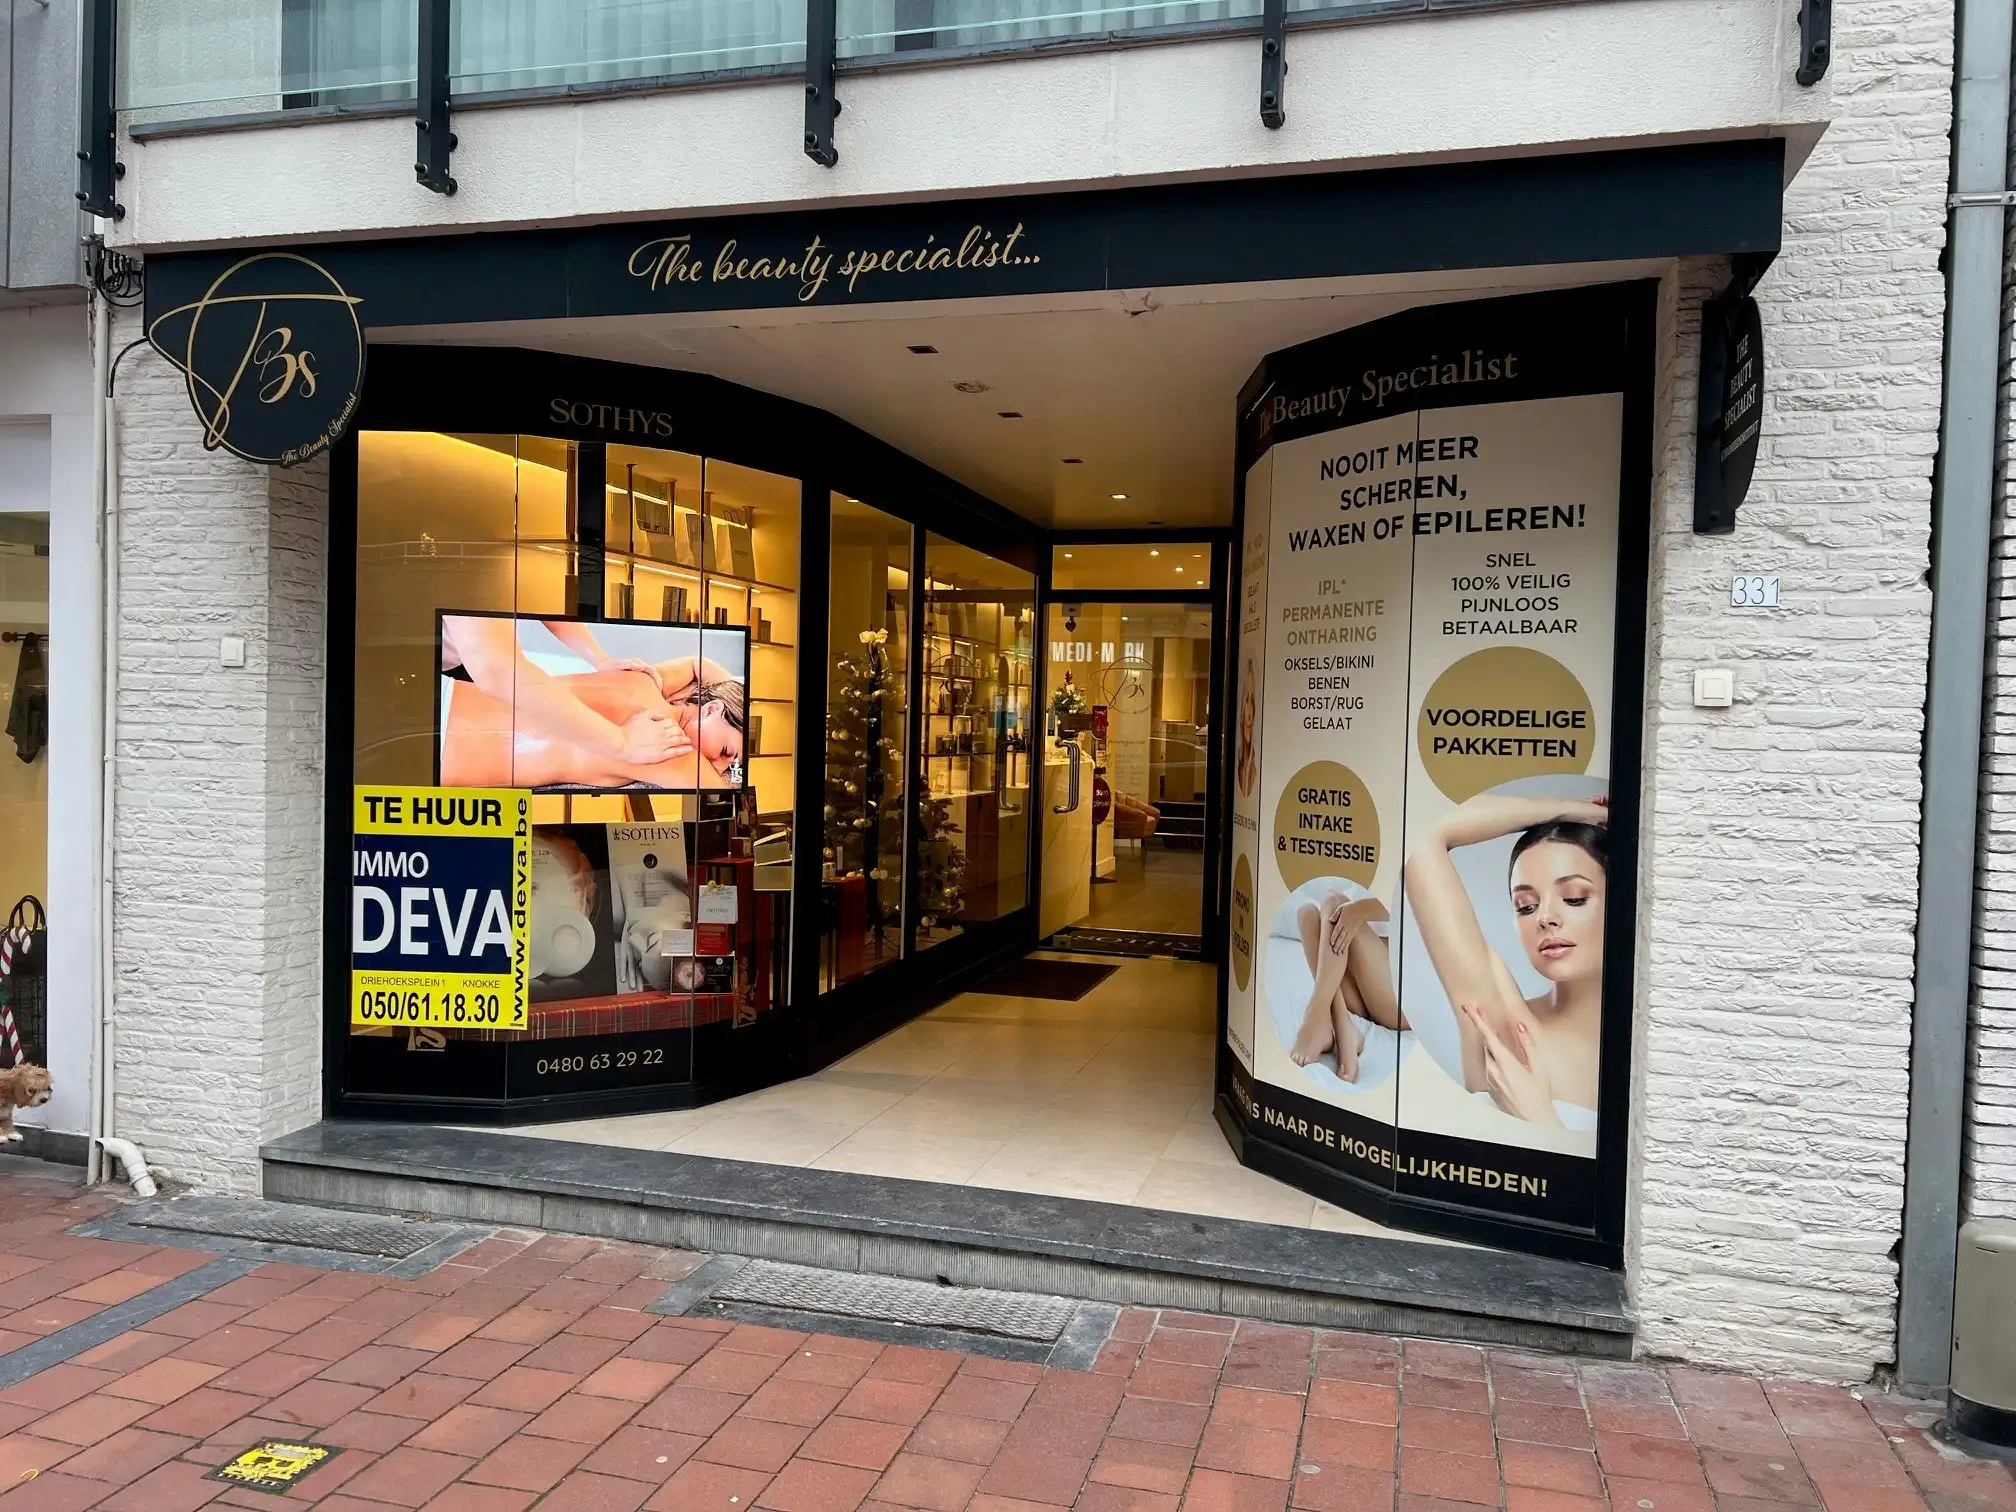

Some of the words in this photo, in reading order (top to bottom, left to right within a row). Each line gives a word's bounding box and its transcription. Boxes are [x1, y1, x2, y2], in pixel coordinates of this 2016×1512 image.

[628, 234, 702, 291] The
[713, 236, 834, 302] beauty
[838, 222, 1041, 293] specialist...
[1273, 384, 1351, 424] Beauty
[1362, 350, 1518, 407] Specialist
[1730, 358, 1753, 398] BEAUTY
[550, 398, 673, 436] SOTHYS
[1724, 383, 1757, 431] SPECIALIST
[299, 434, 330, 458] Beauty
[328, 392, 357, 436] Specialist
[1320, 447, 1389, 481] NOOIT
[1396, 436, 1479, 466] MEER
[1340, 474, 1467, 511] SCHEREN,
[1288, 521, 1365, 552] WAXEN
[1373, 516, 1404, 540] OF
[1412, 503, 1586, 535] EPILEREN!
[1486, 553, 1536, 568] SNEL
[1451, 575, 1500, 591] 100%
[1506, 573, 1571, 590] VEILIG
[1733, 577, 1780, 606] 331
[1282, 600, 1384, 622] PERMANENTE
[1461, 597, 1559, 613] PIJNLOOS
[1287, 626, 1377, 646] ONTHARING
[1442, 618, 1577, 636] BETAALBAAR
[1284, 655, 1375, 671] OKSELS/BIKINI
[1308, 677, 1350, 690] BENEN
[1291, 696, 1364, 711] BORST/RUG
[1303, 717, 1353, 731] GELAAT
[1427, 708, 1587, 729] VOORDELIGE
[1433, 736, 1577, 758] PAKKETTEN
[1298, 787, 1351, 808] GRATIS
[364, 796, 403, 824] TE
[412, 797, 502, 827] HUUR
[1299, 812, 1353, 834] INTAKE
[621, 827, 680, 841] SOTHYS
[1277, 836, 1287, 851] &
[1290, 837, 1375, 863] TESTSESSIE
[354, 850, 429, 878] IMMO
[353, 885, 513, 958] DEVA
[512, 797, 527, 1022] www.deva.be
[360, 976, 440, 987] DRIEHOEKSPLEIN
[462, 979, 500, 989] KNOKKE
[360, 990, 499, 1023] 050/61.18.30
[537, 1056, 583, 1074] 0480
[590, 1053, 610, 1069] 63
[616, 1051, 637, 1067] 29
[643, 1049, 664, 1064] 22
[1264, 1107, 1308, 1138] NAAR
[1313, 1126, 1335, 1148] DE
[1340, 1134, 1548, 1198] MOGELIJKHEDEN!
